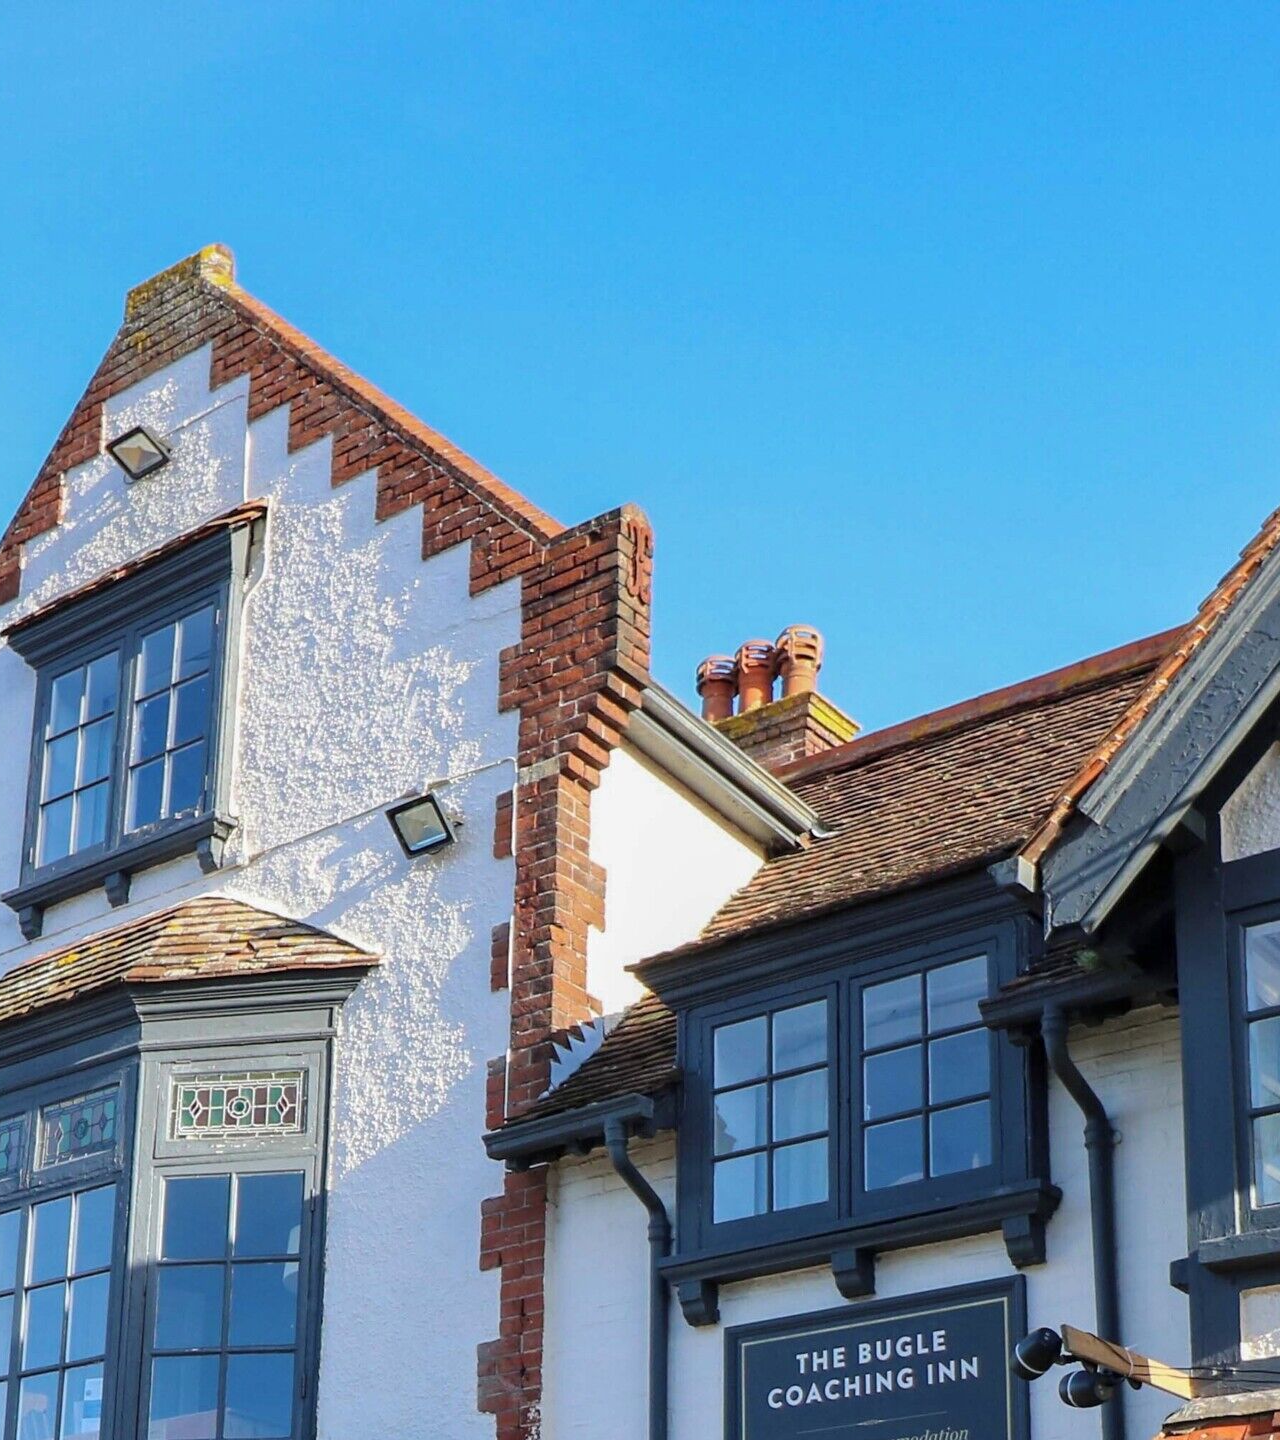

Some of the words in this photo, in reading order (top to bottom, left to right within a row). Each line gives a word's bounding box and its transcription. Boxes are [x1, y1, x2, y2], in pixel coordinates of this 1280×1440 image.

[796, 1346, 845, 1374] THE
[858, 1329, 947, 1364] BUGLE
[767, 1367, 914, 1409] COACHING
[927, 1356, 979, 1385] INN
